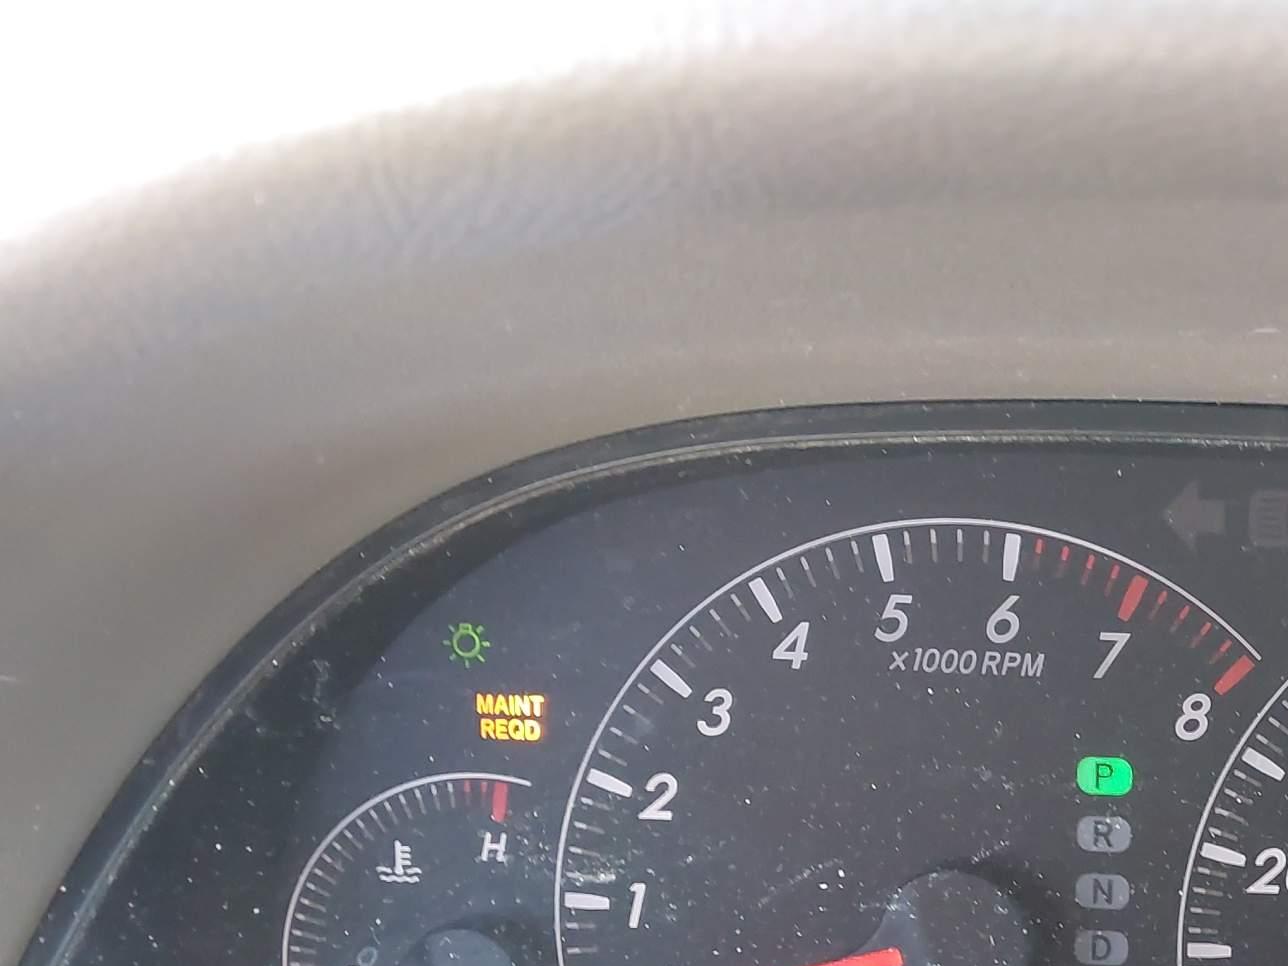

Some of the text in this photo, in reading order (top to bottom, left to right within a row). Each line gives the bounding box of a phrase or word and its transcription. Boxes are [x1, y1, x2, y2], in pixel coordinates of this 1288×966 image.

[875, 594, 913, 642] 5
[986, 595, 1021, 643] 6
[773, 622, 810, 669] 4
[1092, 632, 1130, 679] 7
[980, 652, 1045, 678] RPM
[476, 694, 544, 717] MAINT
[697, 689, 732, 736] 3
[1174, 693, 1212, 740] 8
[480, 719, 542, 741] REQD
[1094, 763, 1113, 788] P
[639, 773, 678, 820] 2
[481, 832, 507, 861] H
[1093, 823, 1113, 846] R
[630, 882, 647, 928] 1
[1093, 880, 1114, 904] N
[1091, 937, 1111, 961] D
